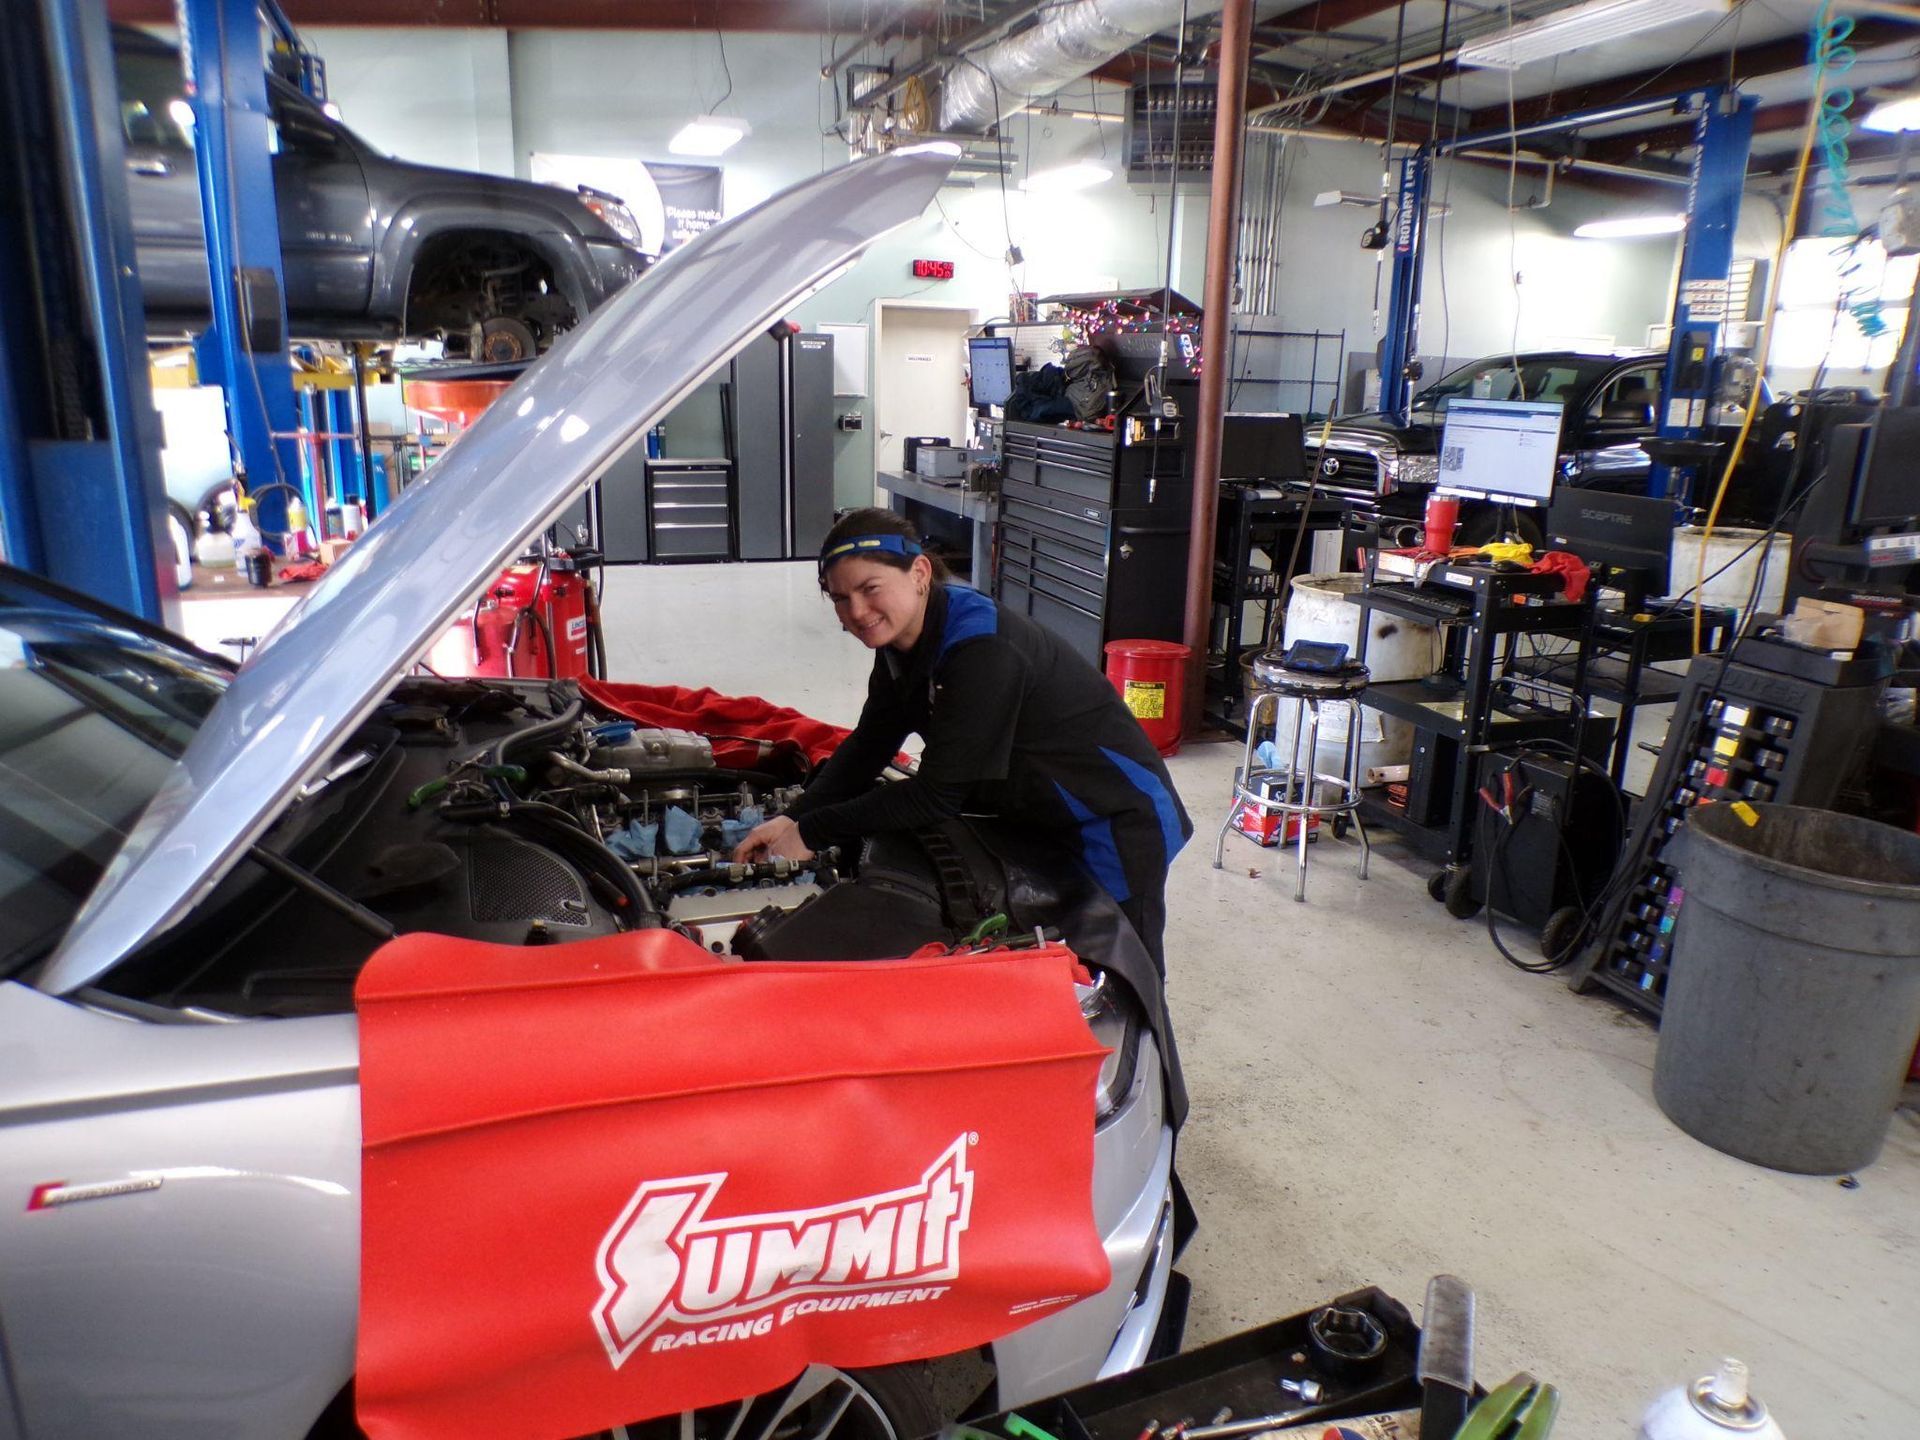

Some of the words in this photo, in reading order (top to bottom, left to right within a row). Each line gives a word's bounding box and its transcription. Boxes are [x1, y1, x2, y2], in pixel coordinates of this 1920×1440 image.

[1404, 159, 1417, 188] LIFT
[1399, 192, 1415, 244] ROTARY
[1581, 508, 1633, 525] SCEPTRE
[651, 1313, 774, 1353] RACING
[779, 1286, 951, 1326] EQUIPMENT
